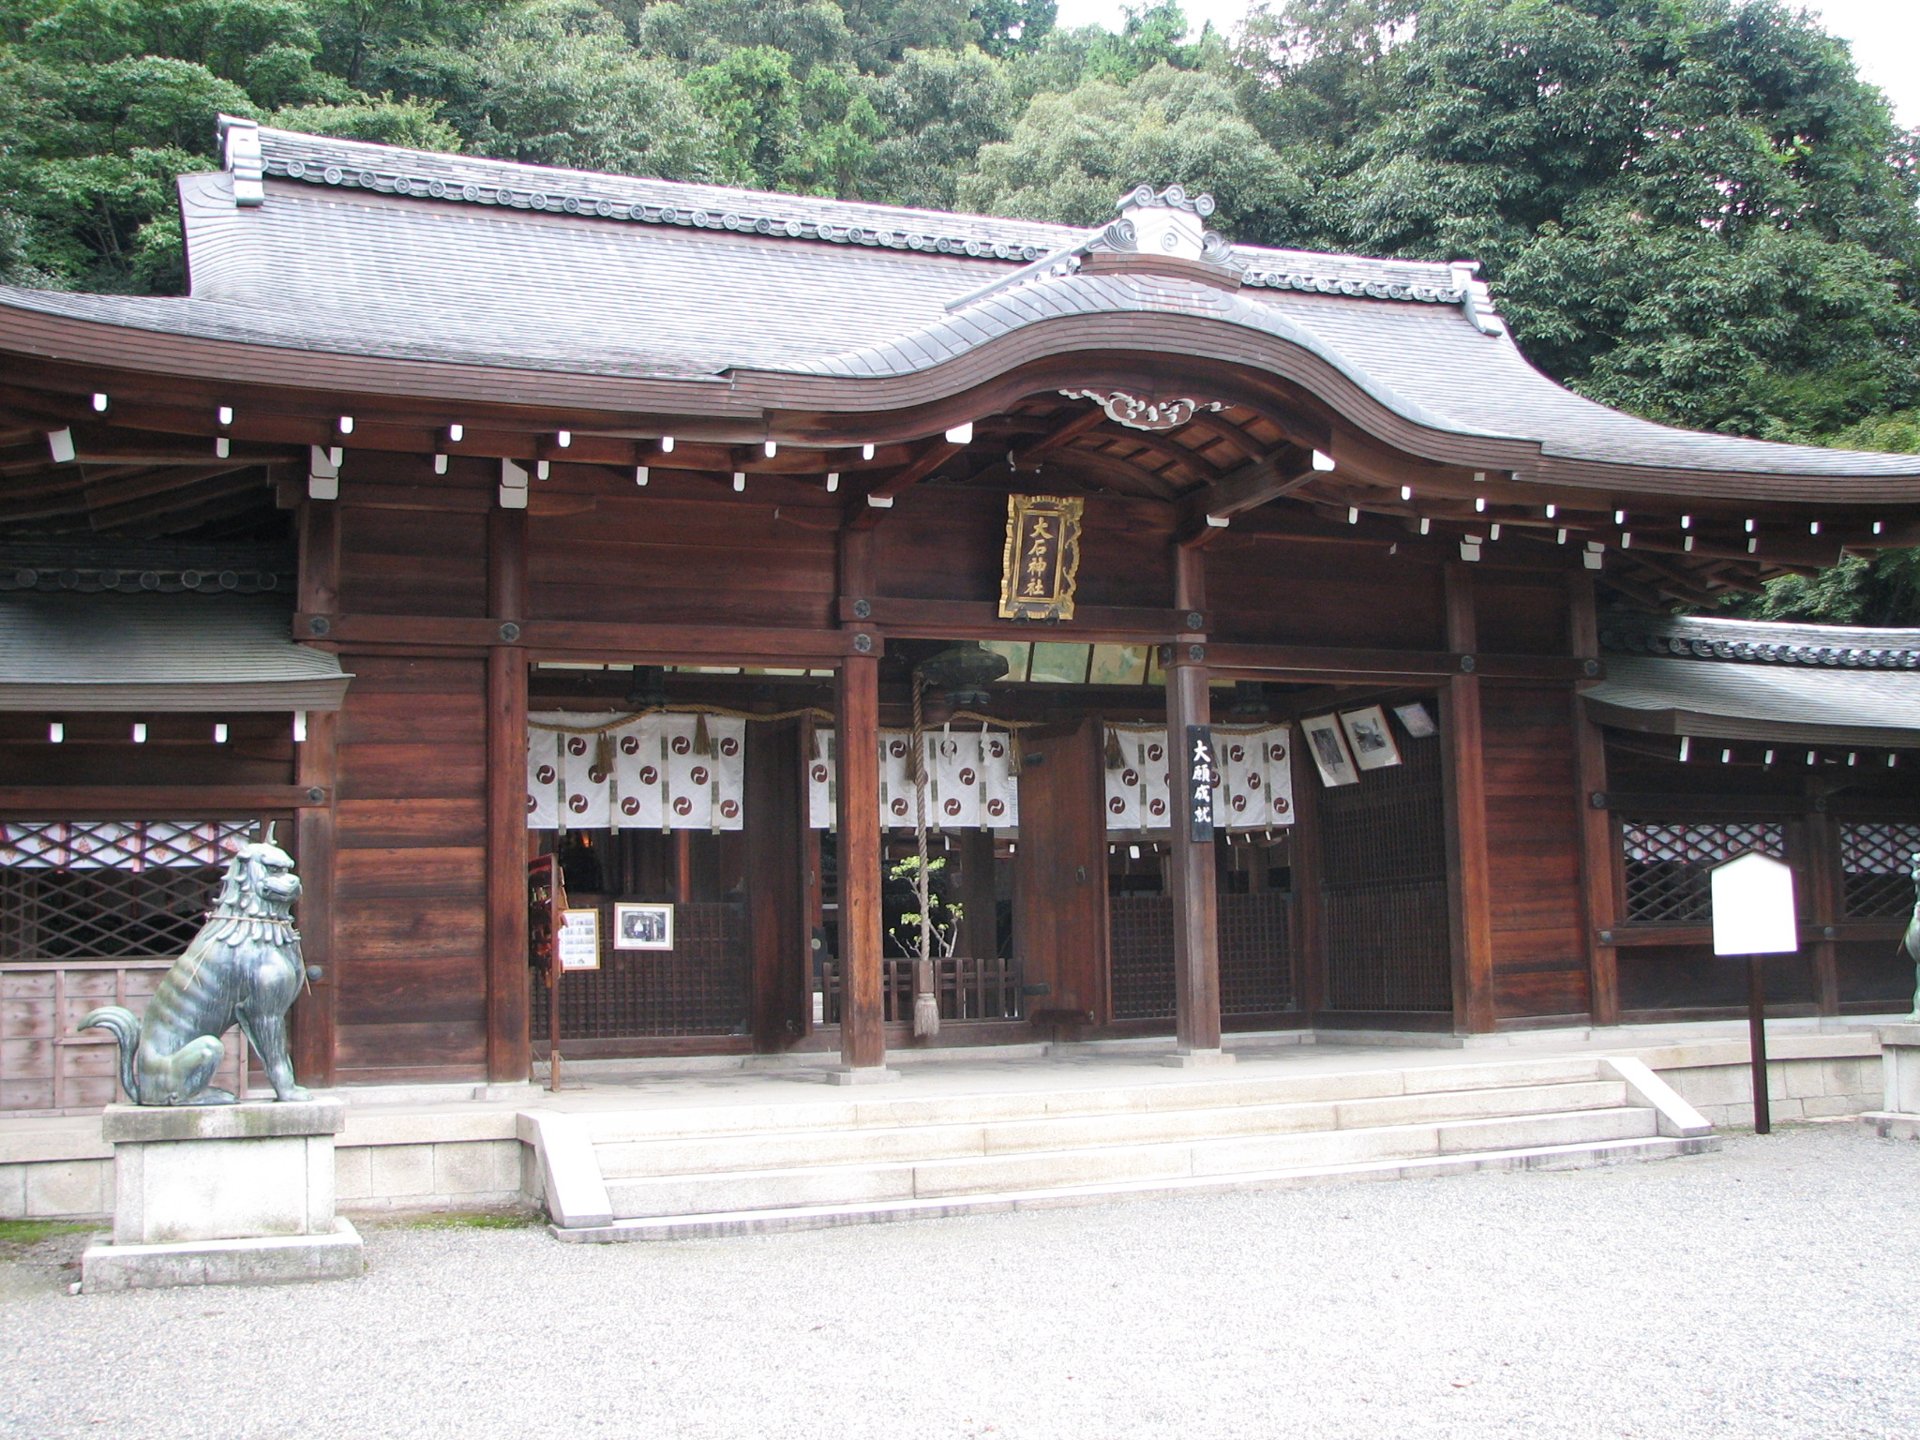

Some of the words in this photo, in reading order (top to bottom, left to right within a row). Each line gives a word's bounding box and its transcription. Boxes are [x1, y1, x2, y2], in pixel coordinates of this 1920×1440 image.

[1024, 517, 1053, 596] 大石神社
[1192, 740, 1211, 823] 大願成就
